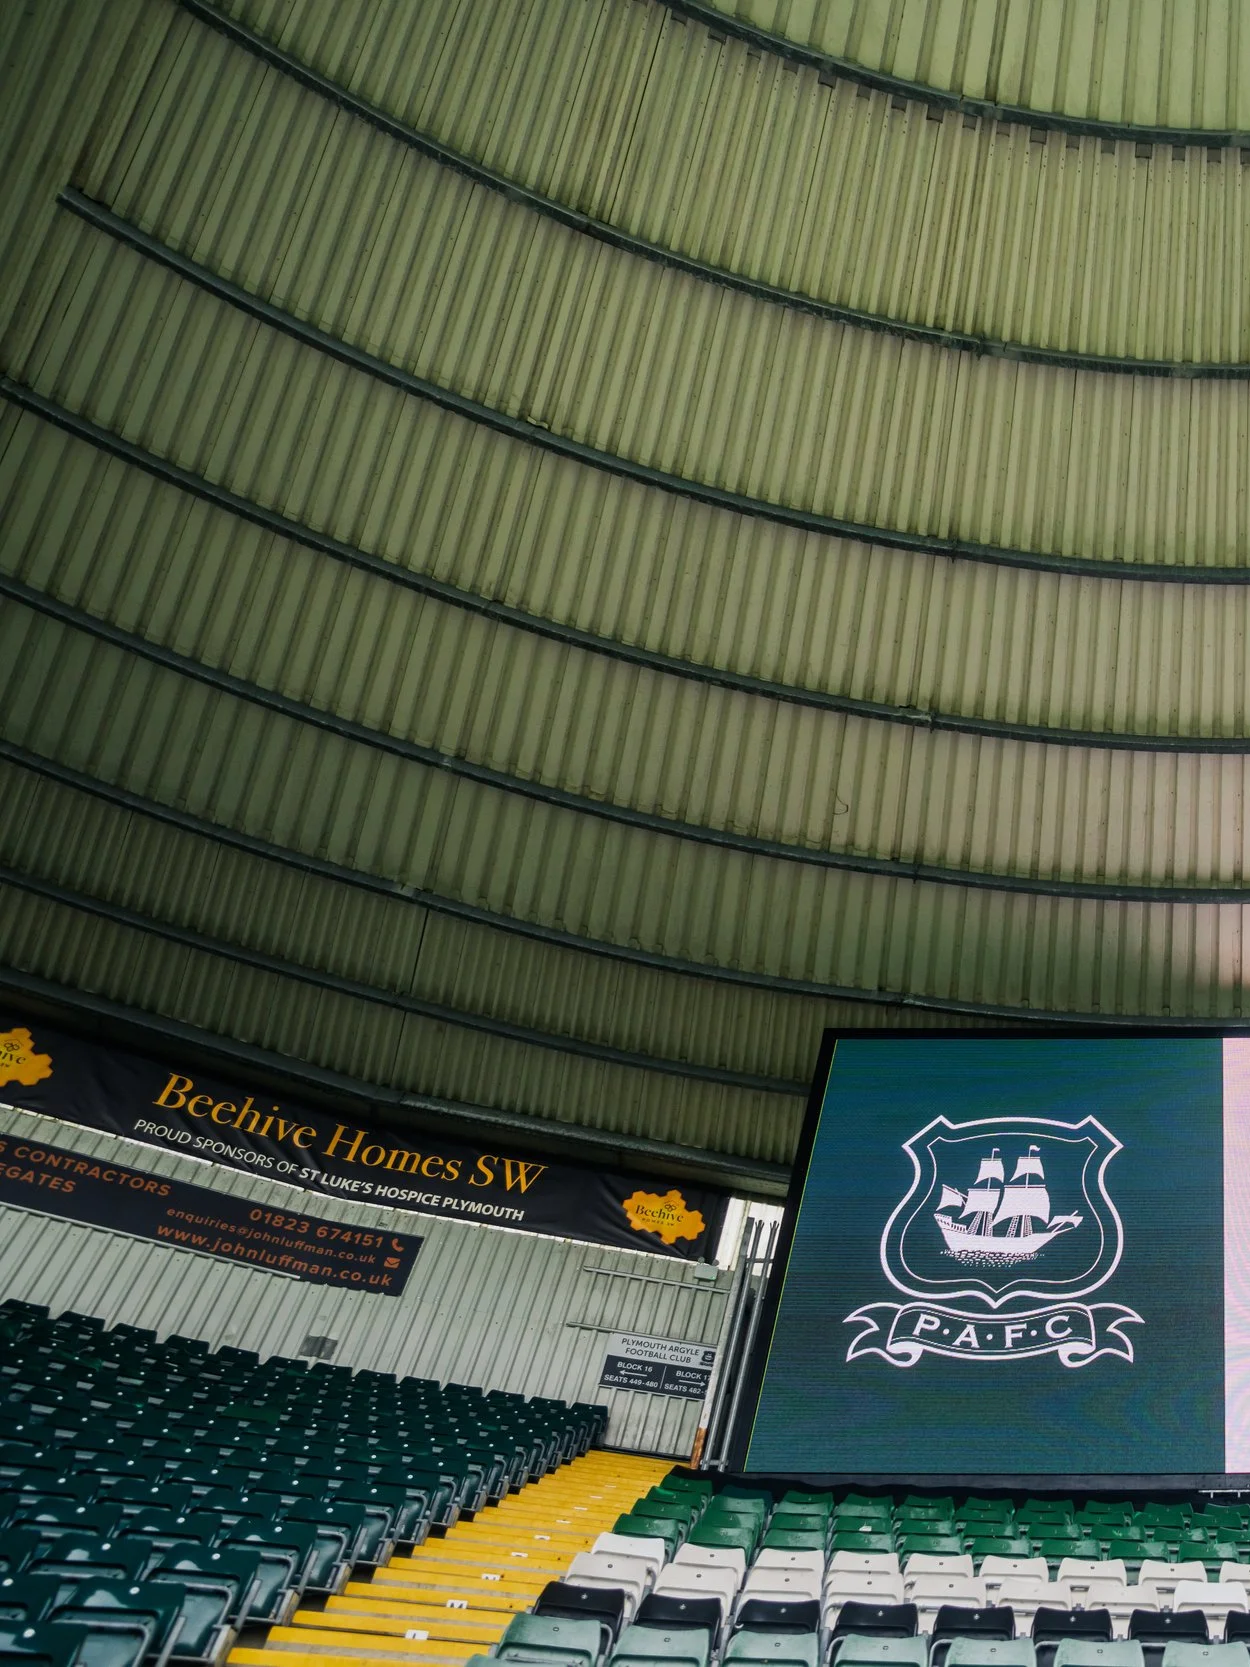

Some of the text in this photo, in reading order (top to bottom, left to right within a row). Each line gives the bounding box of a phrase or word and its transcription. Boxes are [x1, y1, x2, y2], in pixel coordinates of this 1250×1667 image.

[152, 1072, 549, 1194] Beehive Homes SW
[14, 1146, 172, 1196] CONTRACTORS
[134, 1119, 525, 1222] PROUD SPONSORS OF ST LUKE'S HOSPICE PLYMOUTH
[166, 1207, 376, 1264] enquiries@johnluffman.co.uk
[249, 1208, 383, 1248] 01823 674151
[157, 1224, 392, 1287] www.johnluffman.co.uk
[622, 1338, 700, 1356] PLYMOUTH ARGYLE
[625, 1348, 692, 1364] FOOTBALL CLUB
[604, 1374, 628, 1384] SEATS
[618, 1362, 644, 1370] BLOCK
[676, 1370, 702, 1380] BLOCK
[664, 1383, 688, 1392] SEATS
